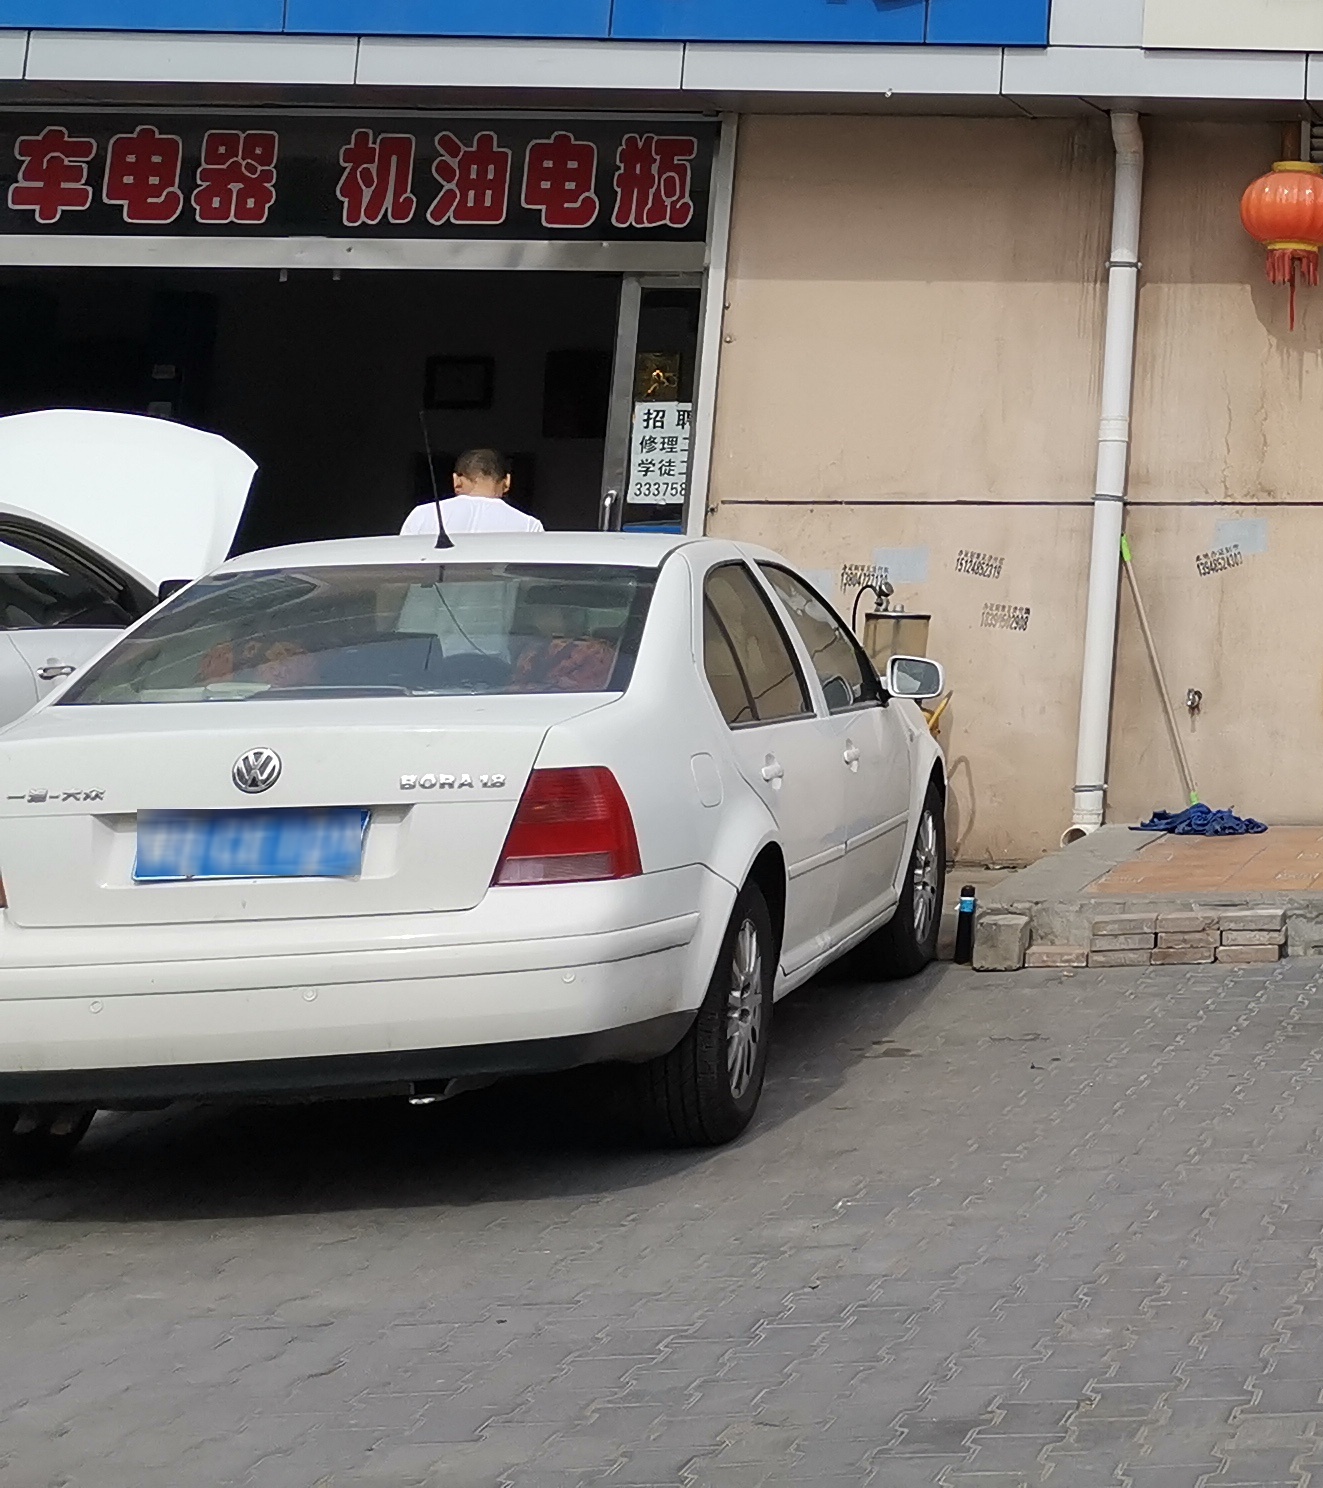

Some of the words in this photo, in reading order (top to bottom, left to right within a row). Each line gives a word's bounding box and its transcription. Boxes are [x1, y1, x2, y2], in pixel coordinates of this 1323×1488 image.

[8, 126, 279, 223] 车电器
[336, 129, 697, 228] 机油电瓶
[399, 773, 475, 790] BORA
